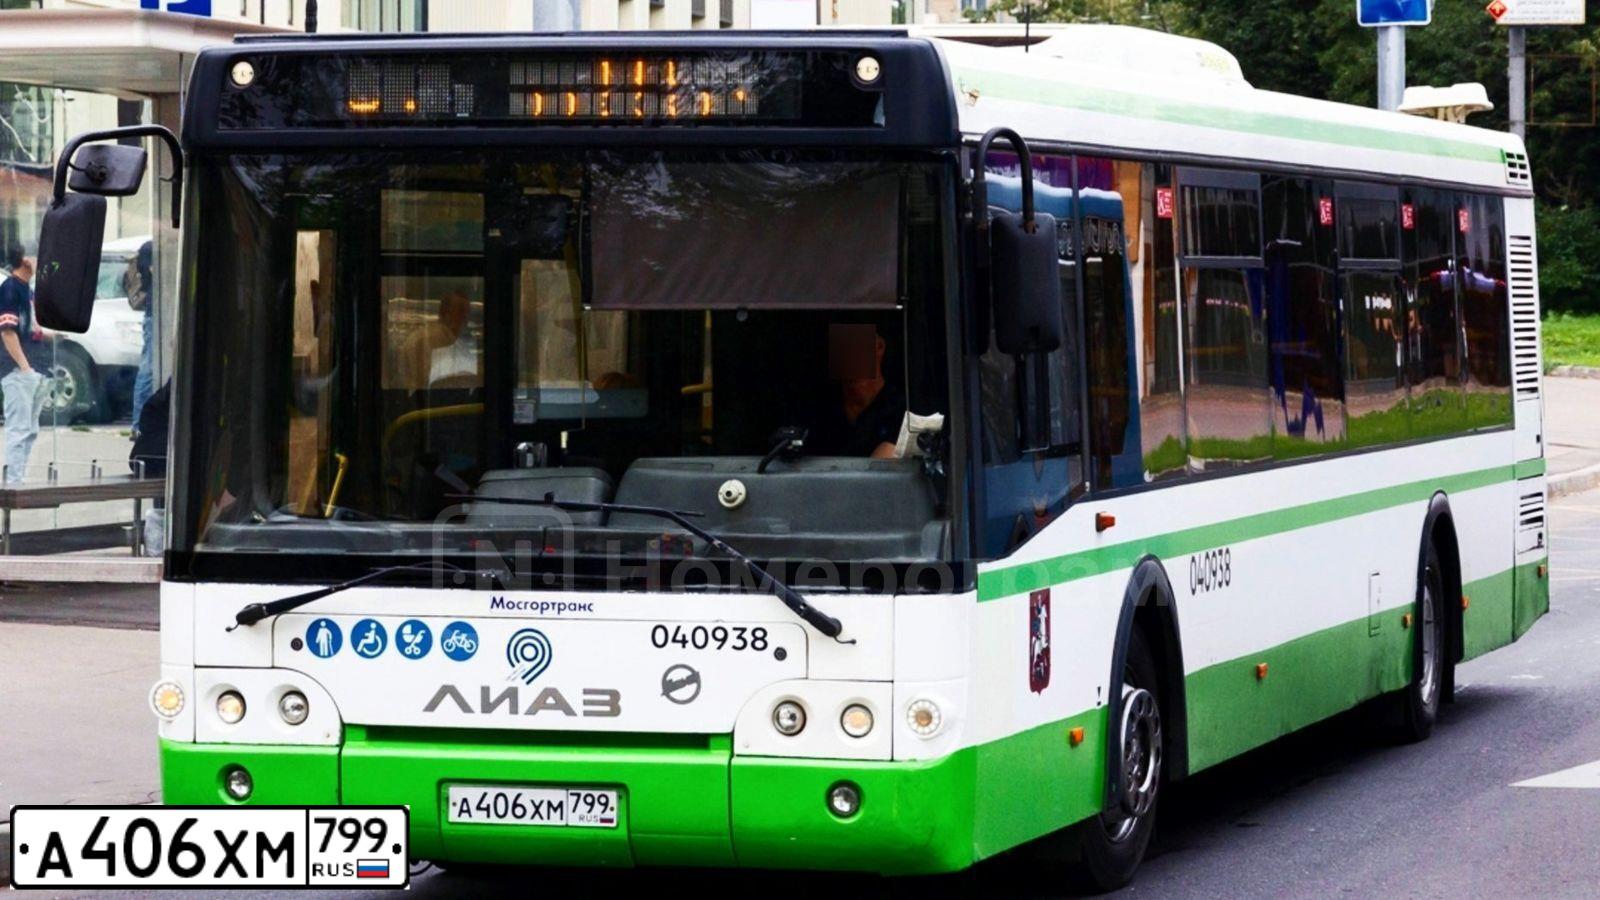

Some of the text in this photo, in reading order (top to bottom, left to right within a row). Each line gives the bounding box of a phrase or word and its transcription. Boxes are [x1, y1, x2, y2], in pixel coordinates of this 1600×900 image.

[1189, 547, 1231, 596] 040938
[490, 596, 594, 614] Мосгортранс
[651, 625, 768, 651] 040938
[423, 685, 621, 717] ЛИАЗ
[569, 792, 610, 814] 799
[578, 814, 599, 823] RUS
